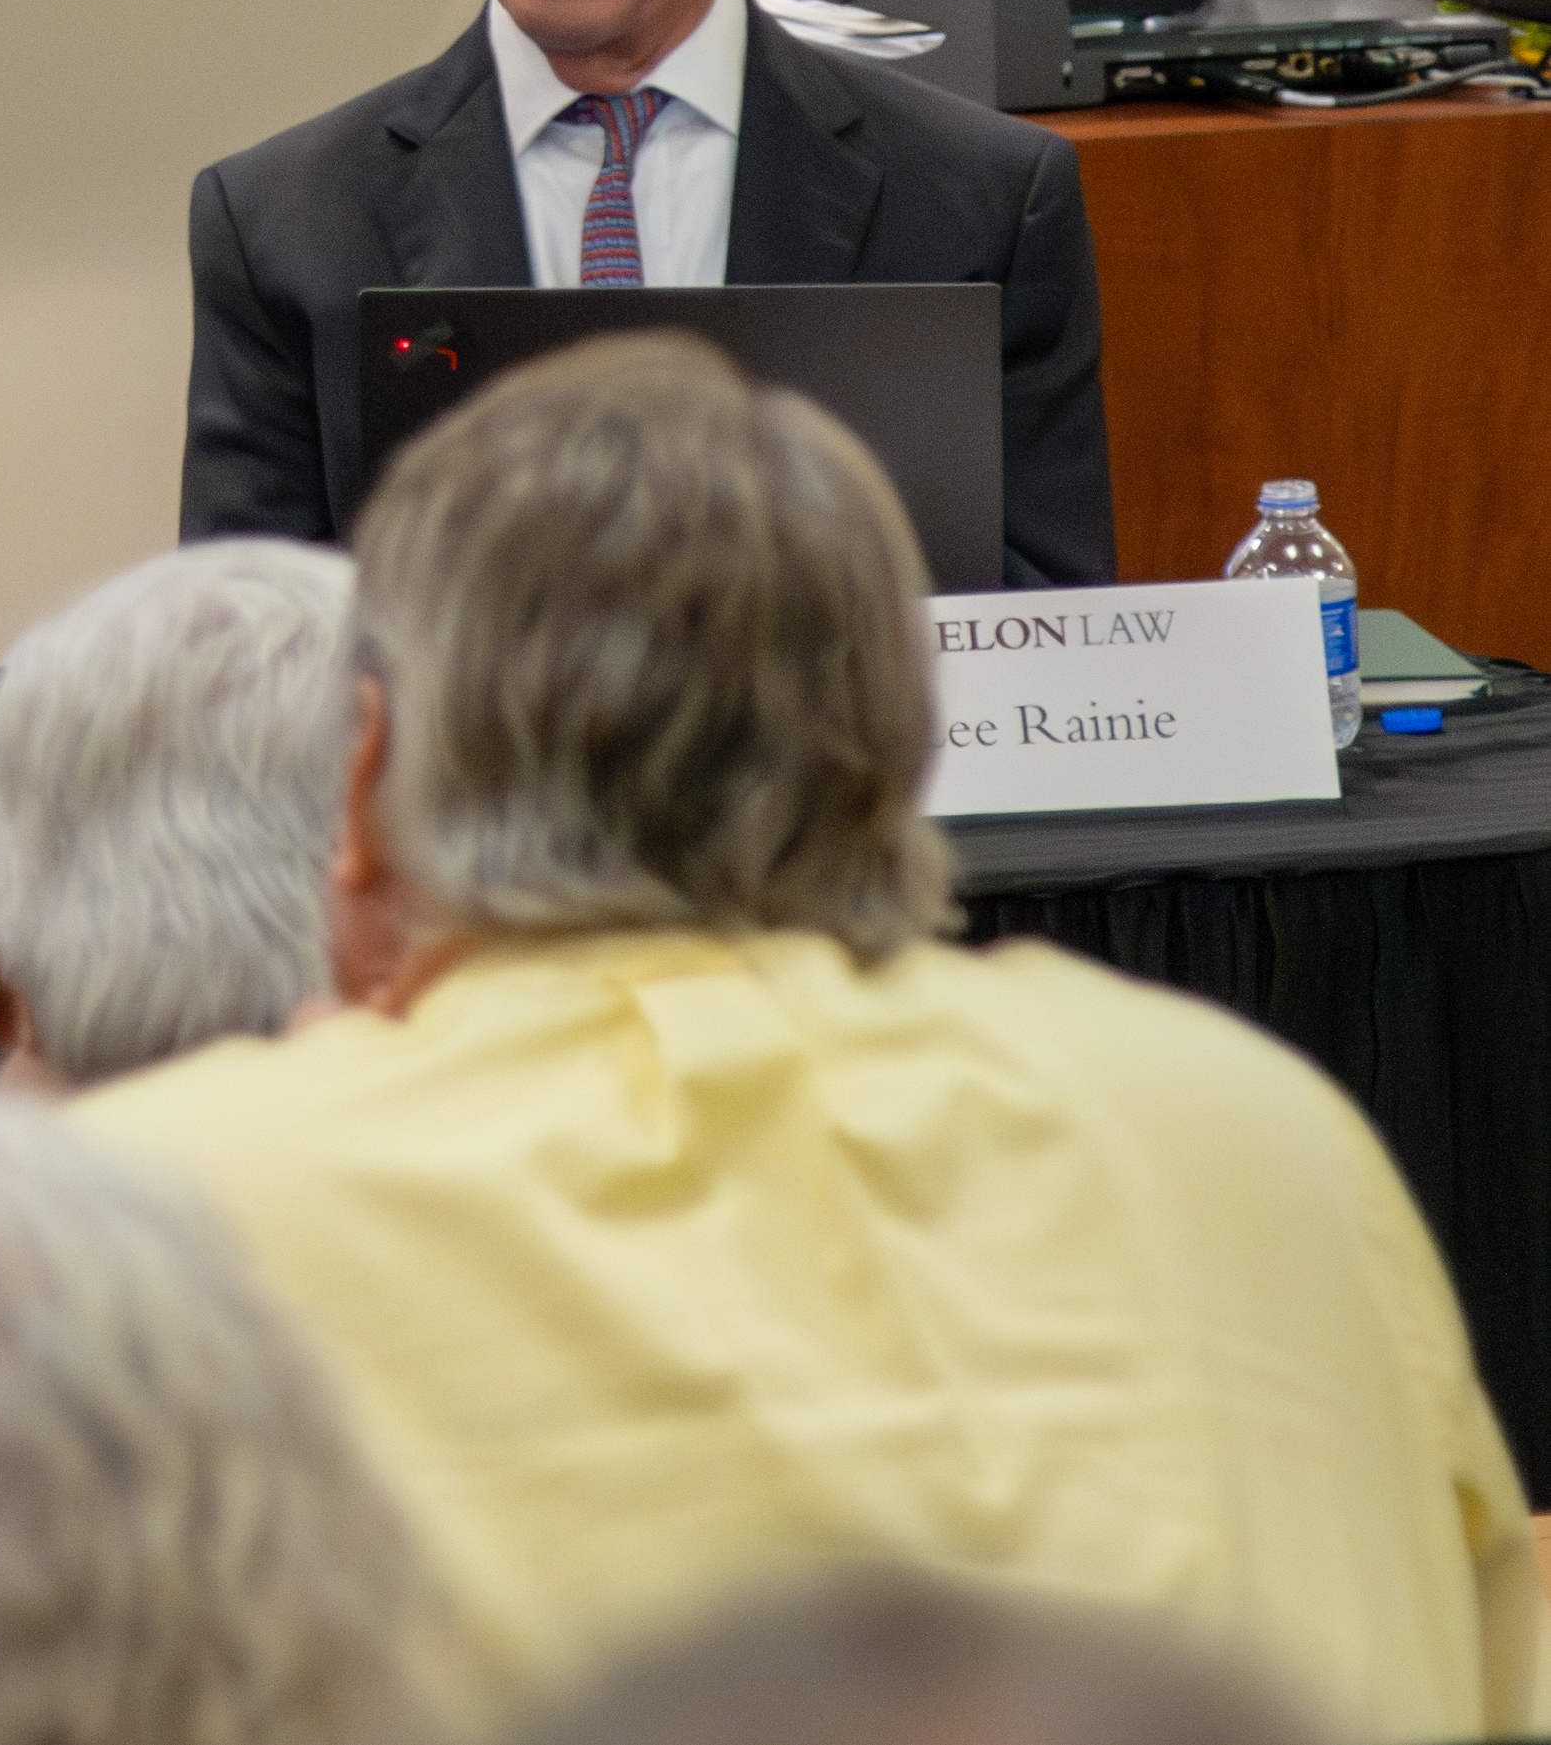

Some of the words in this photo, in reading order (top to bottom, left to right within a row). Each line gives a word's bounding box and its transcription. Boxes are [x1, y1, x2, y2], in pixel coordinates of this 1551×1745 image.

[935, 614, 1069, 653] ELON
[1080, 609, 1176, 647] LAW
[935, 718, 998, 749] ee
[1015, 699, 1177, 746] Rainie
